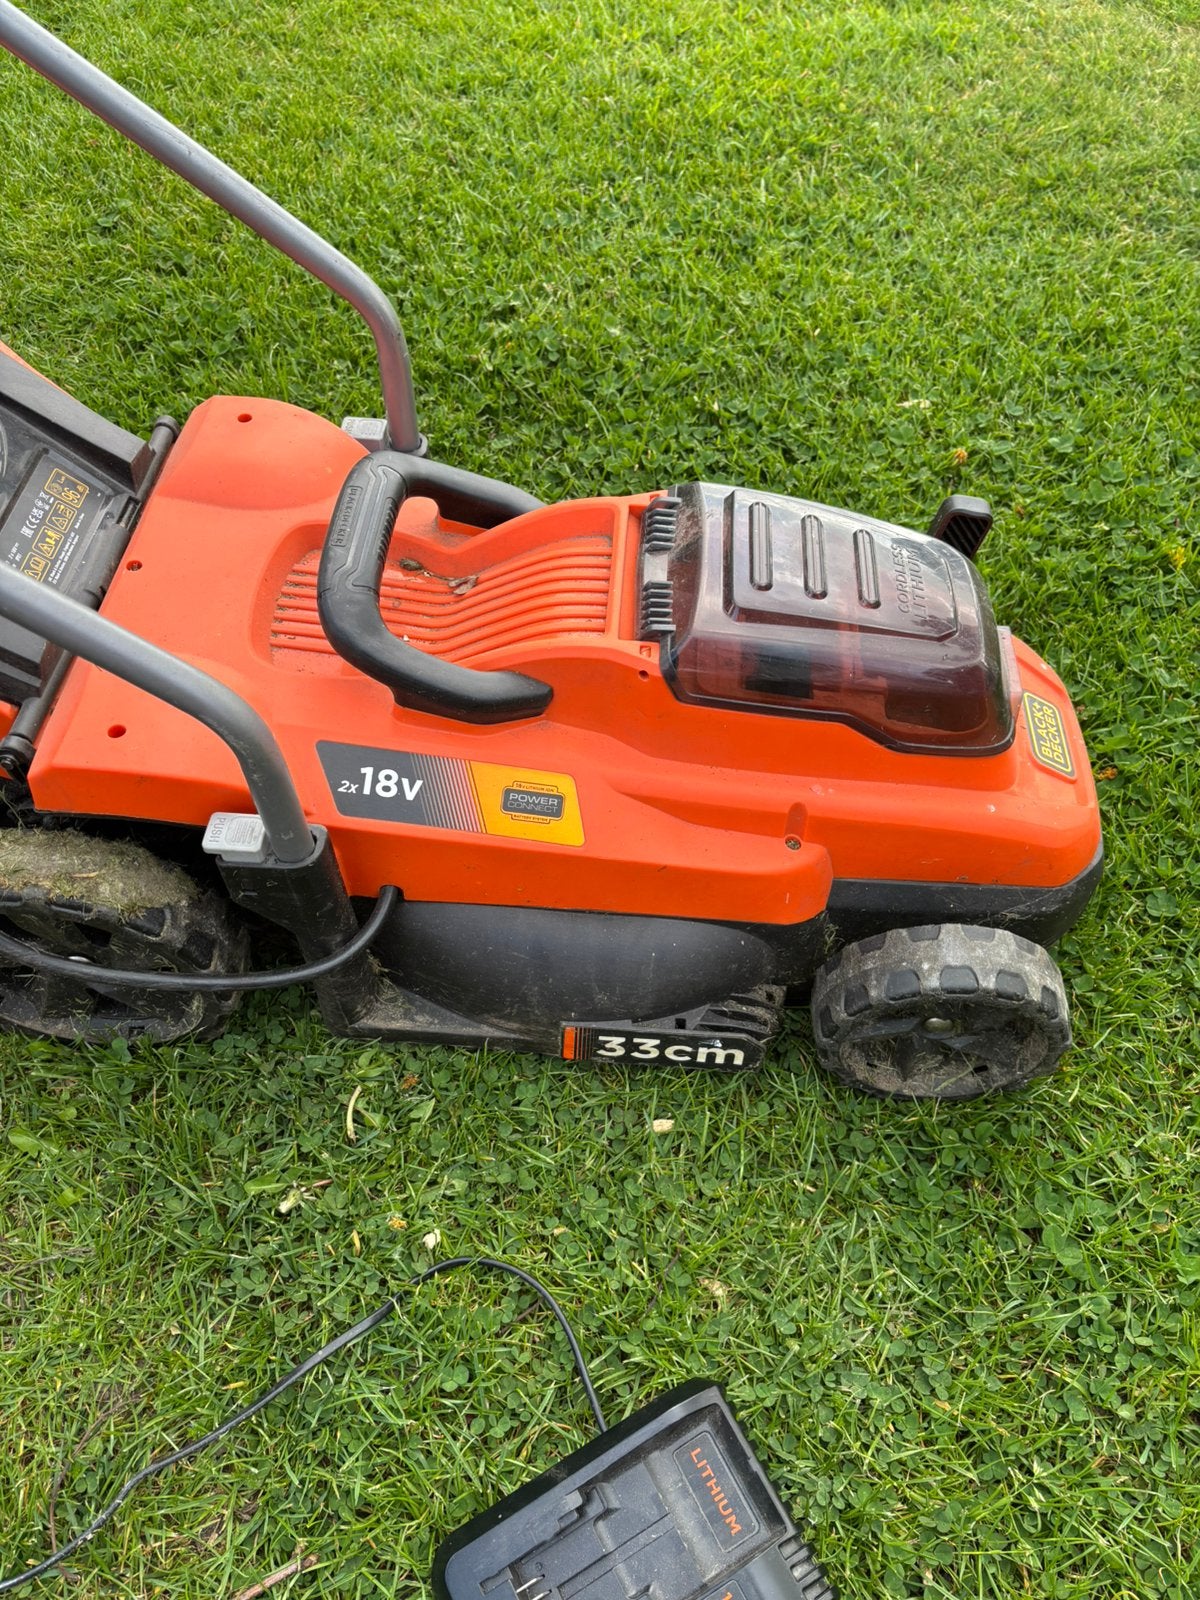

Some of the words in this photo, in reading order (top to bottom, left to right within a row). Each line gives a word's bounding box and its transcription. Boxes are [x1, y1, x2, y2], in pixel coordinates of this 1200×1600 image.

[62, 487, 80, 503] 96
[891, 543, 910, 614] CORDLESS
[907, 548, 928, 620] LITHIUM
[1042, 705, 1065, 764] DECKER
[507, 800, 558, 813] CONNECT
[509, 792, 558, 806] POWER
[209, 817, 226, 843] PUSH
[596, 1035, 745, 1066] 33cm
[690, 1447, 742, 1537] LITHIUM
